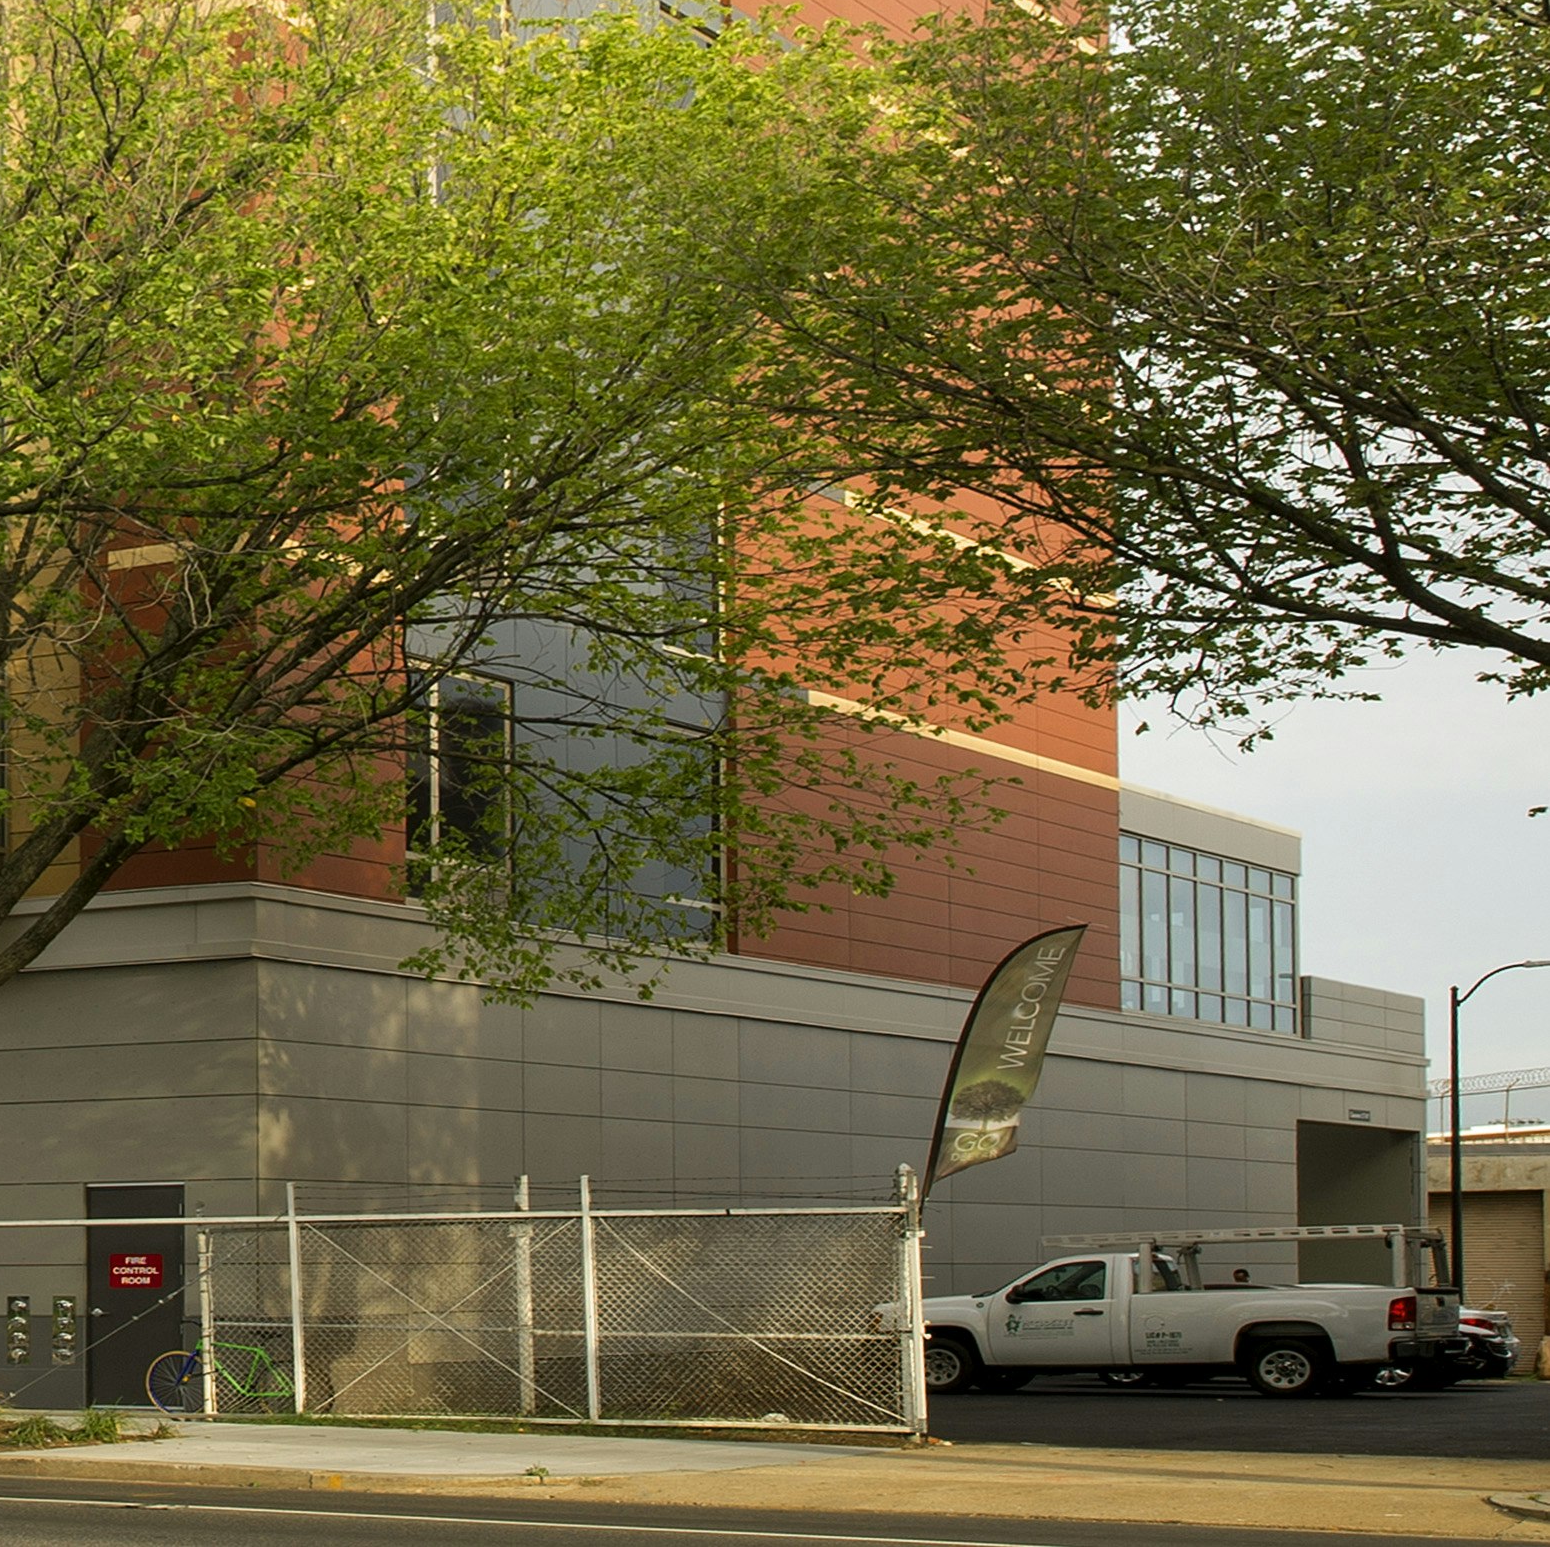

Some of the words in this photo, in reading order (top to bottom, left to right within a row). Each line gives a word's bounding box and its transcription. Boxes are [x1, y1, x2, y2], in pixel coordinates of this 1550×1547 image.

[996, 947, 1066, 1070] WELCOME
[954, 1132, 1000, 1152] GO
[125, 1256, 147, 1265] FIRE
[112, 1266, 160, 1275] CONTROL
[121, 1276, 151, 1285] ROOM
